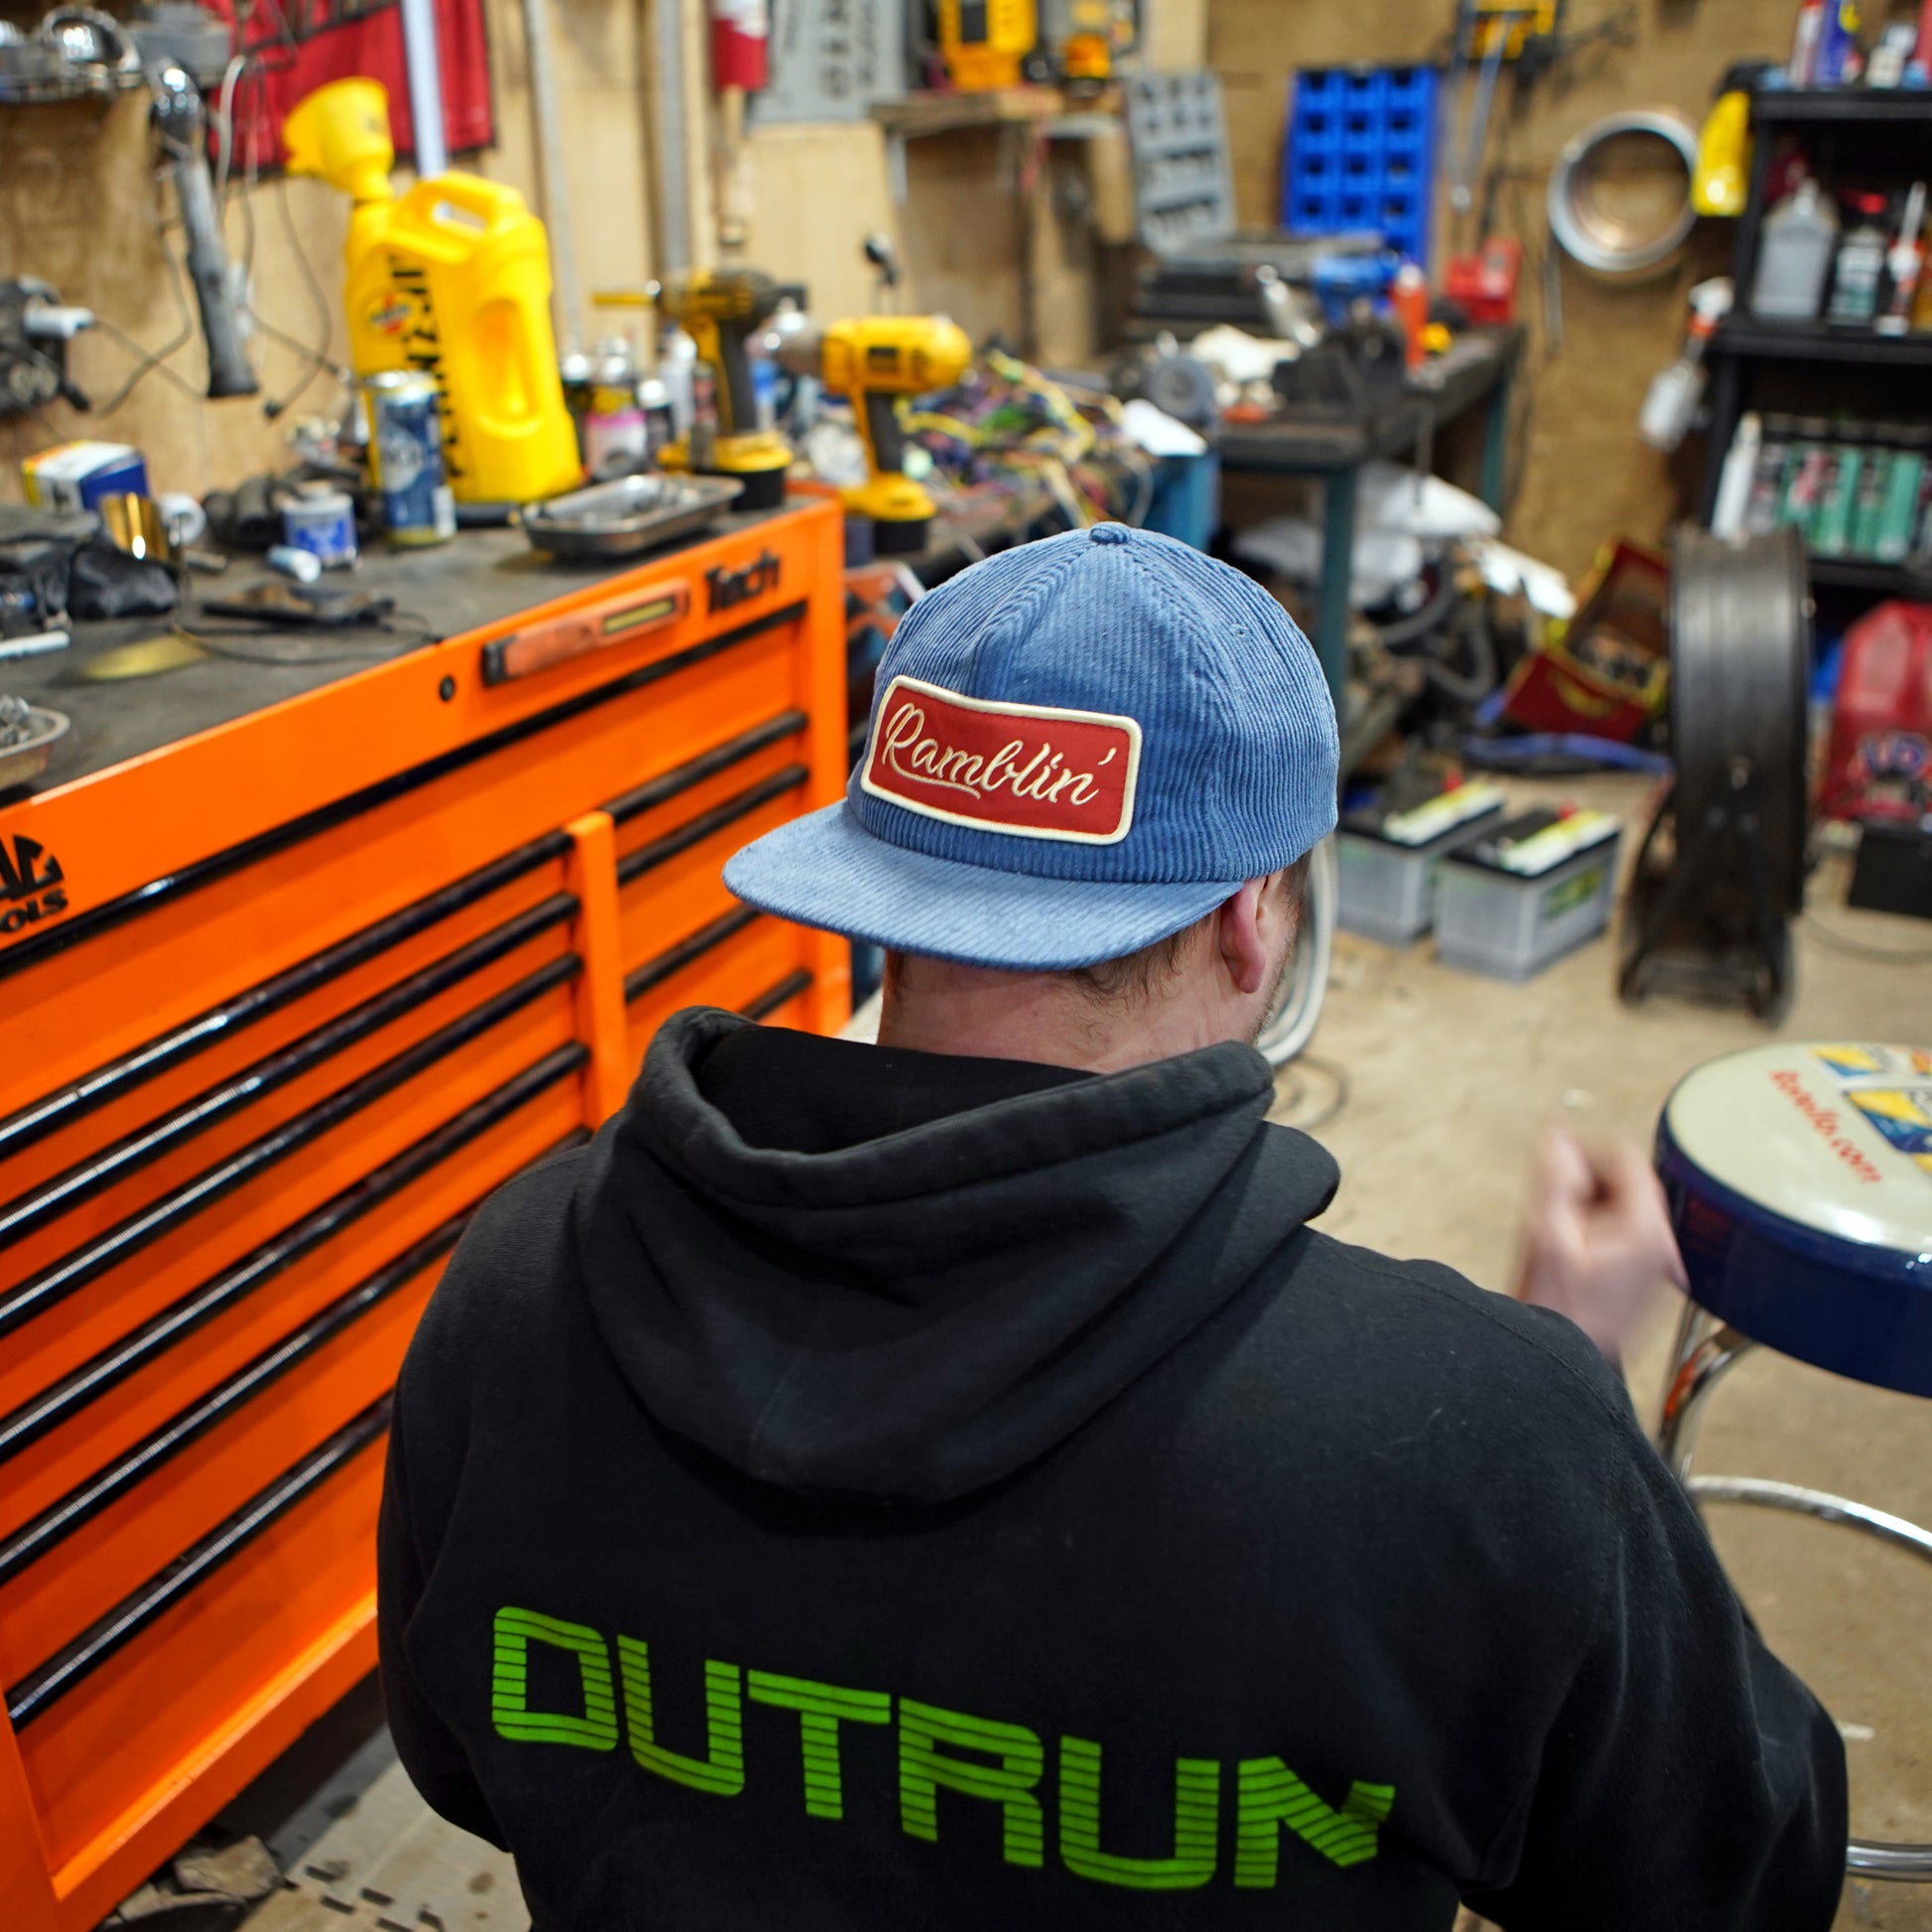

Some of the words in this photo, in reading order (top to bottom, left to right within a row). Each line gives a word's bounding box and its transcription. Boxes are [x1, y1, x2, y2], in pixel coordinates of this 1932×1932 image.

[882, 702, 1117, 806] Ramblin'
[0, 889, 69, 932] OLS
[491, 1605, 1395, 1889] OUTRUN
